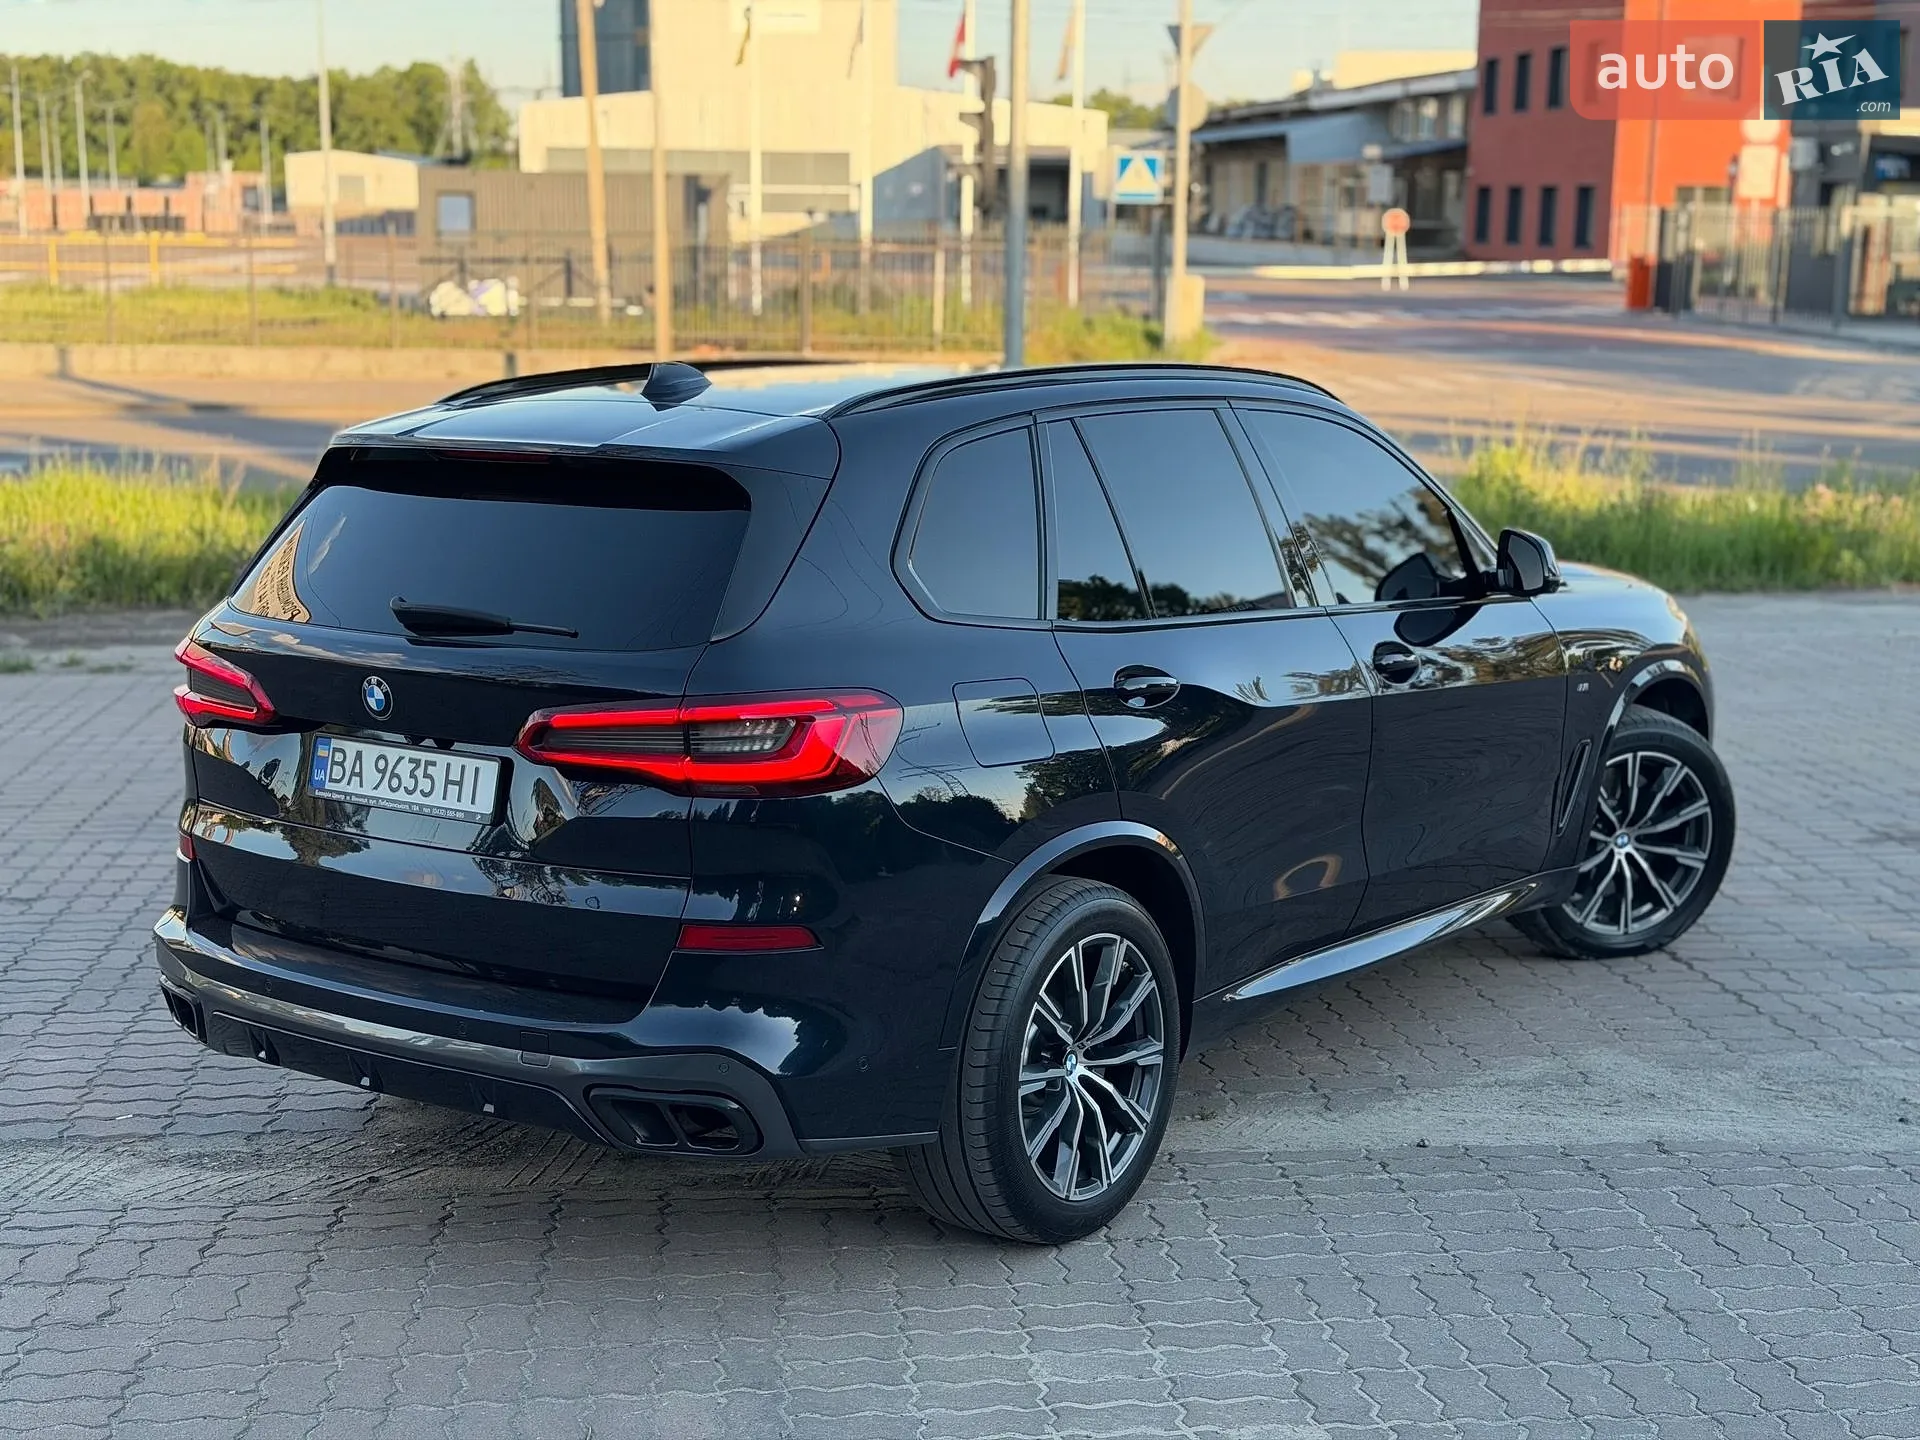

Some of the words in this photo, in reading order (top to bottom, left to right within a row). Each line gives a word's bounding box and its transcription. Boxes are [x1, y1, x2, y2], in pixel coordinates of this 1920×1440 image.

[314, 769, 325, 781] UA
[328, 746, 364, 788] BA
[372, 753, 437, 798] 9635
[442, 762, 481, 805] HI
